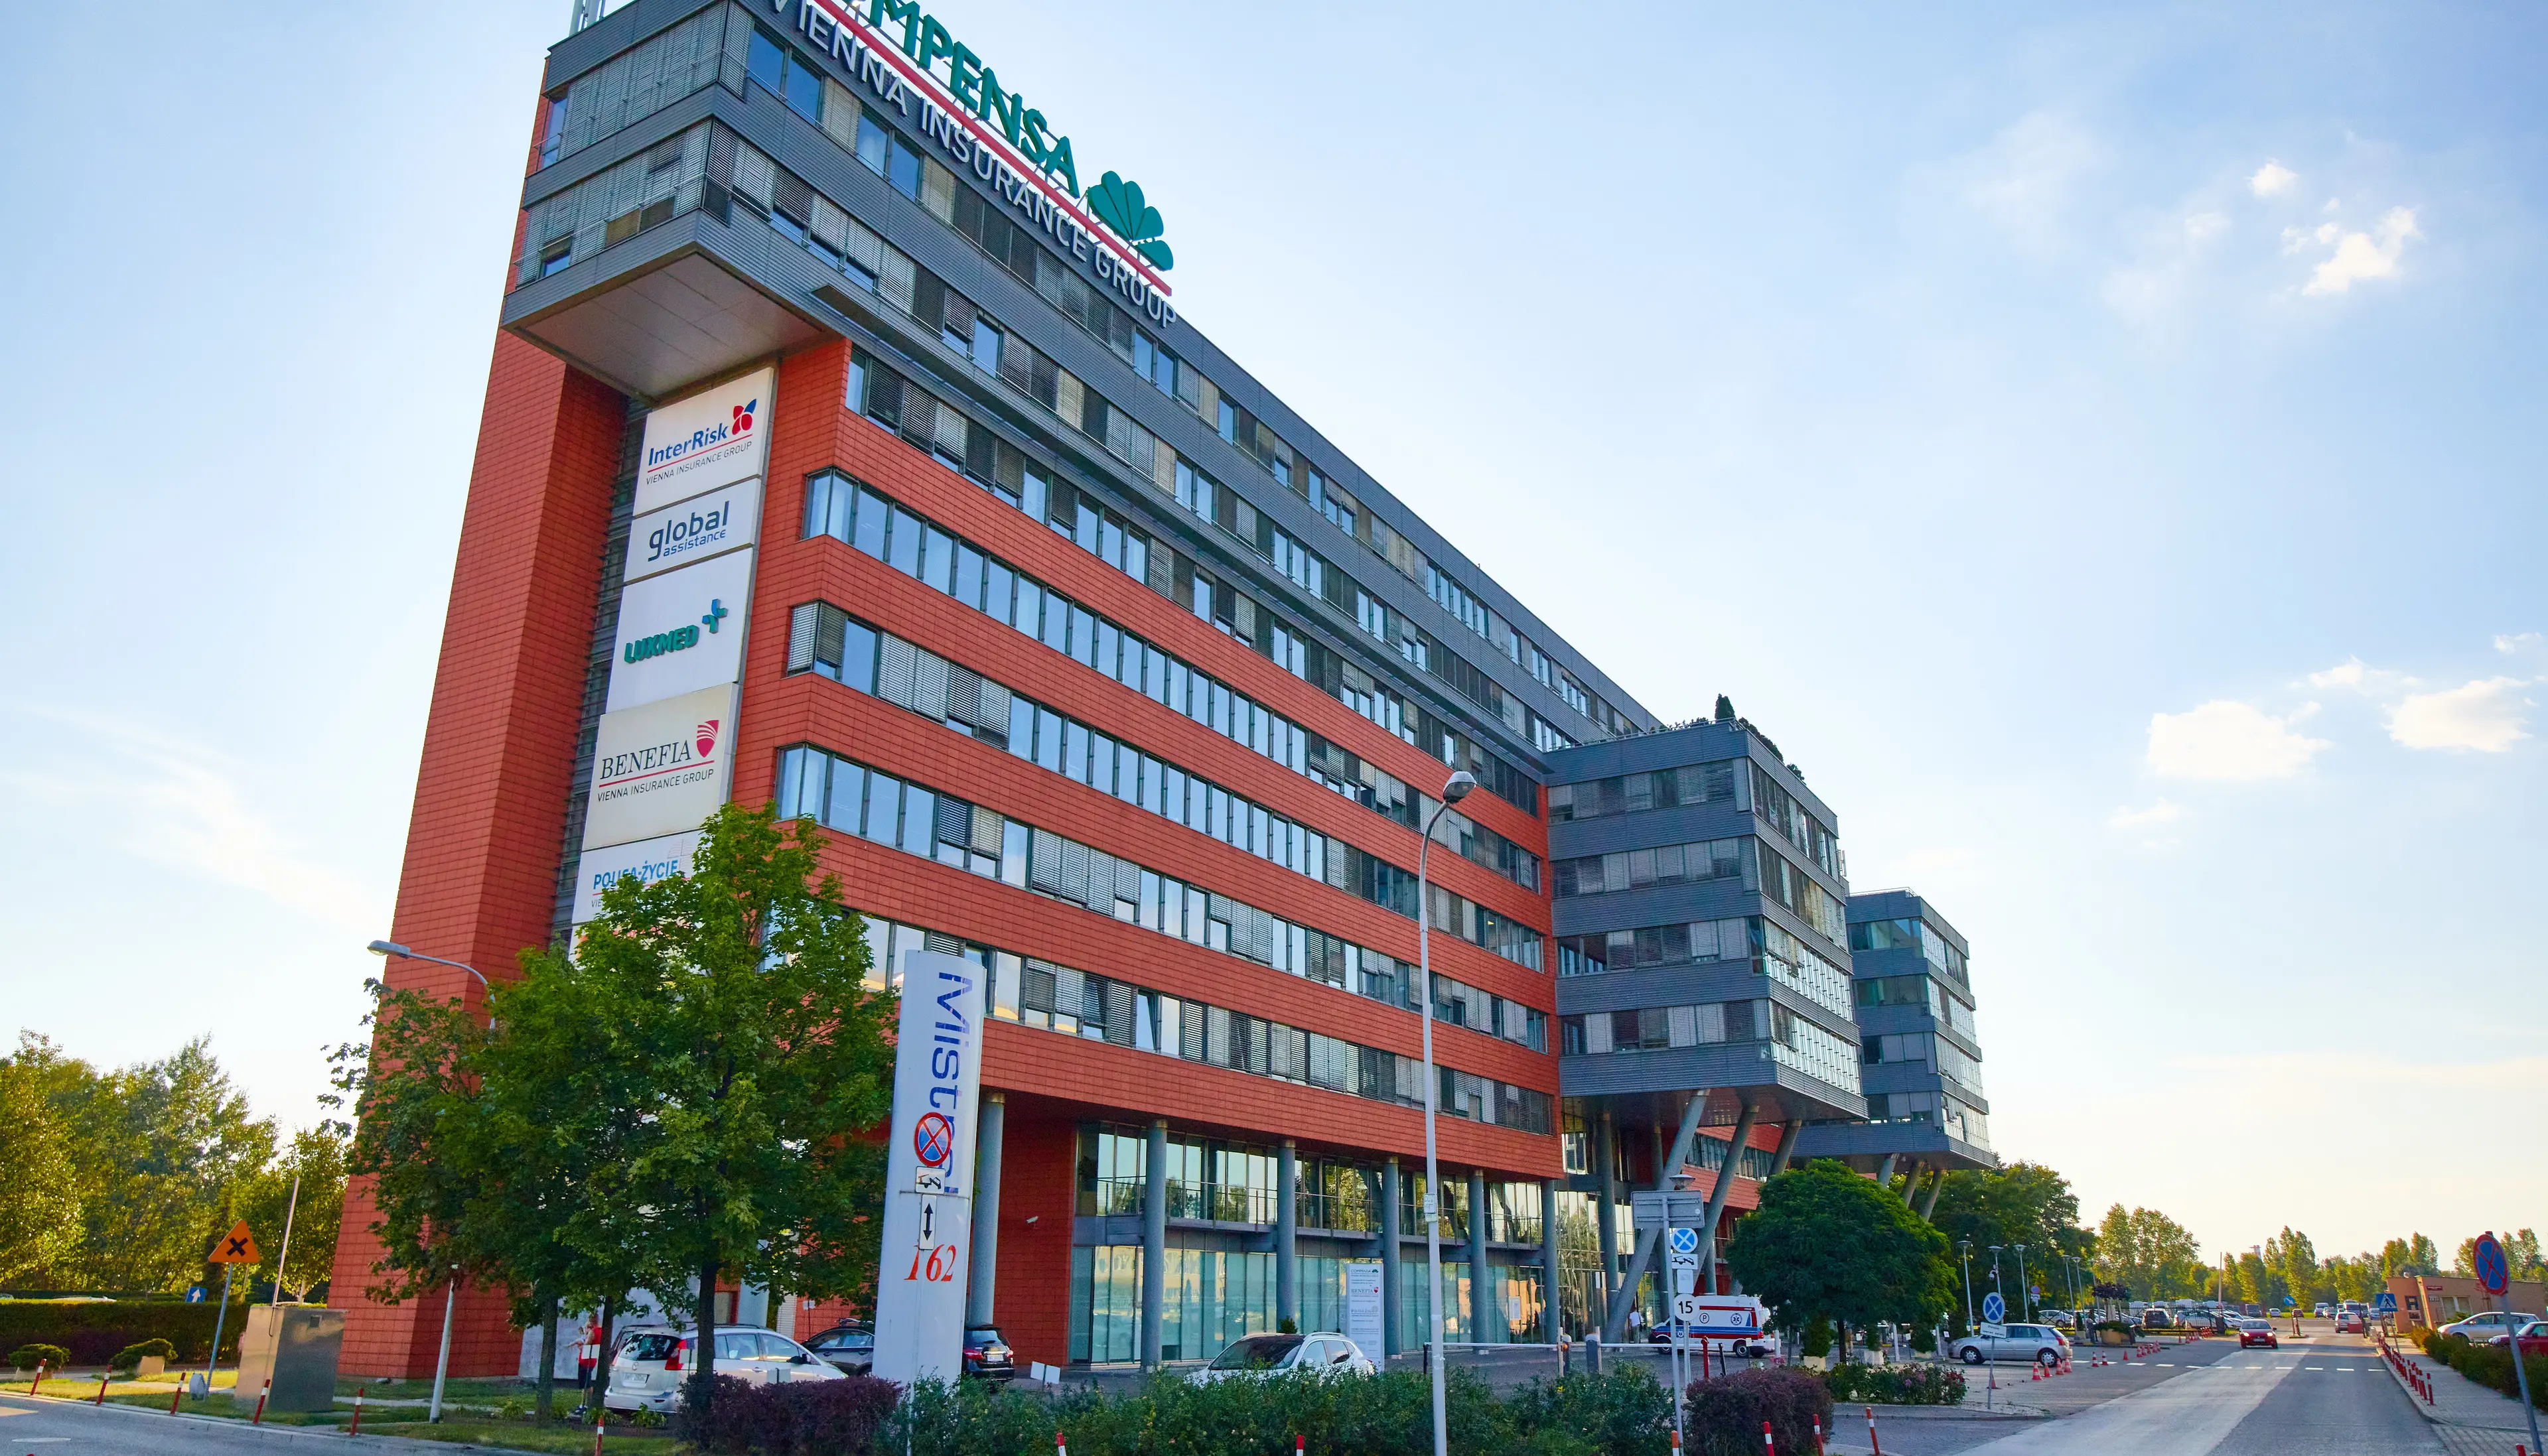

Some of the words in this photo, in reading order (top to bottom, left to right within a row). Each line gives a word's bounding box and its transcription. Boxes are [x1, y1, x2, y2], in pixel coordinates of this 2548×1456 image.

[920, 98, 1088, 261] INSURANCE
[1094, 241, 1177, 328] GROUP
[646, 470, 674, 485] VIENNA
[677, 452, 722, 475] INSURANCE
[724, 441, 752, 458] GROUP
[648, 423, 729, 466] InterRisk
[648, 501, 729, 562] global
[664, 529, 726, 557] assistance
[624, 624, 700, 663] LUXMED
[600, 740, 691, 779] BENEFIA
[598, 787, 628, 802] VIENNA
[630, 775, 680, 795] INSURANCE
[683, 769, 714, 783] GROUP
[904, 1244, 957, 1282] 162
[1678, 1301, 1693, 1314] 15
